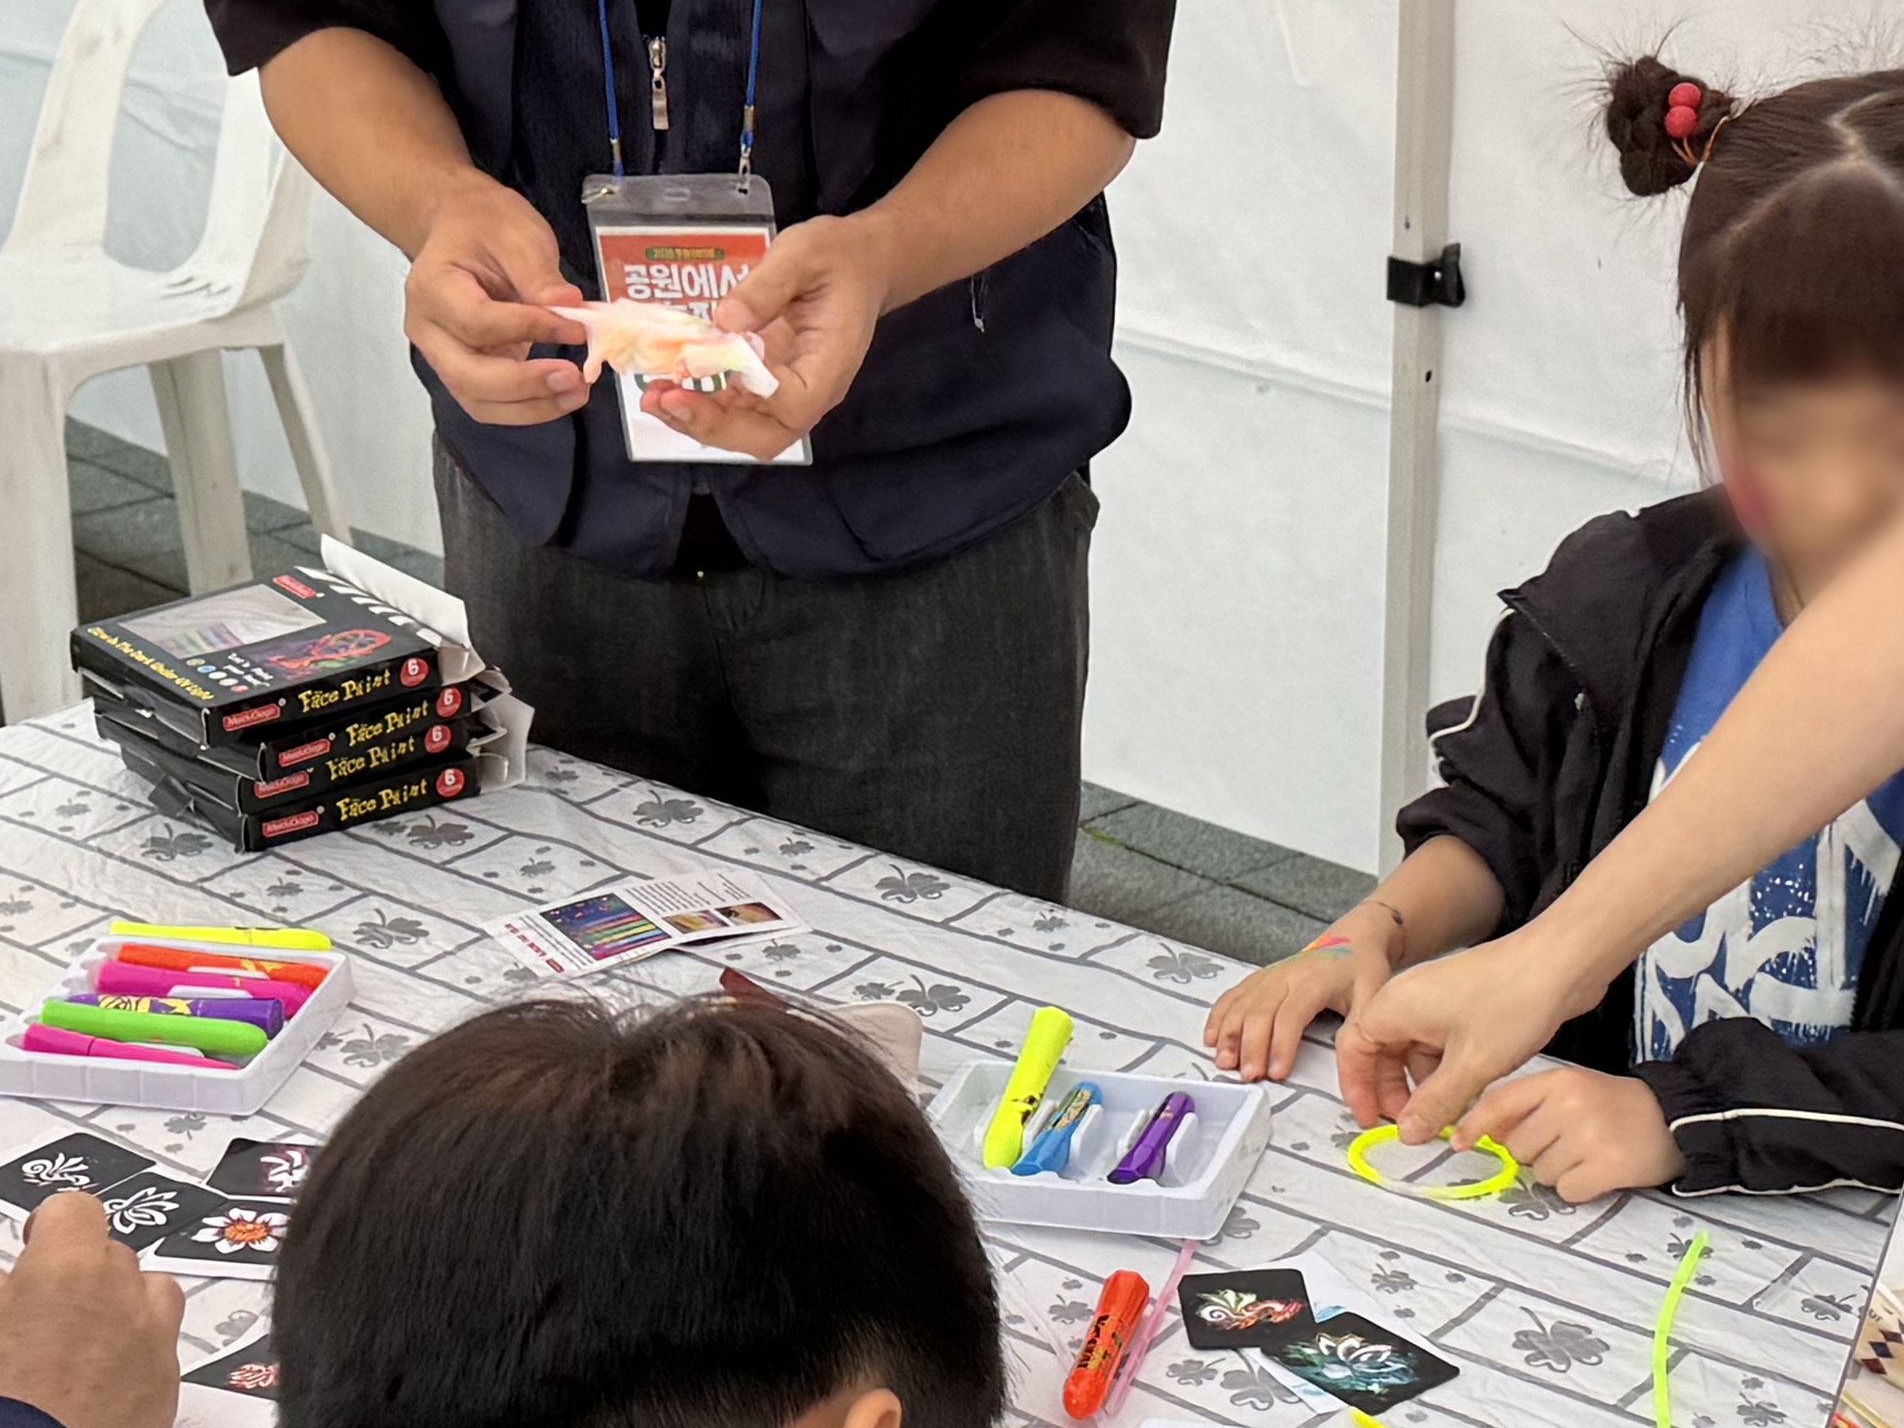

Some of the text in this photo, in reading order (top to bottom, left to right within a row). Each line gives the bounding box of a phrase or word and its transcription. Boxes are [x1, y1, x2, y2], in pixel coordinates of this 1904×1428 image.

[407, 657, 420, 675] 6
[443, 688, 454, 705] 6
[431, 725, 443, 742] 6
[444, 769, 456, 786] 6
